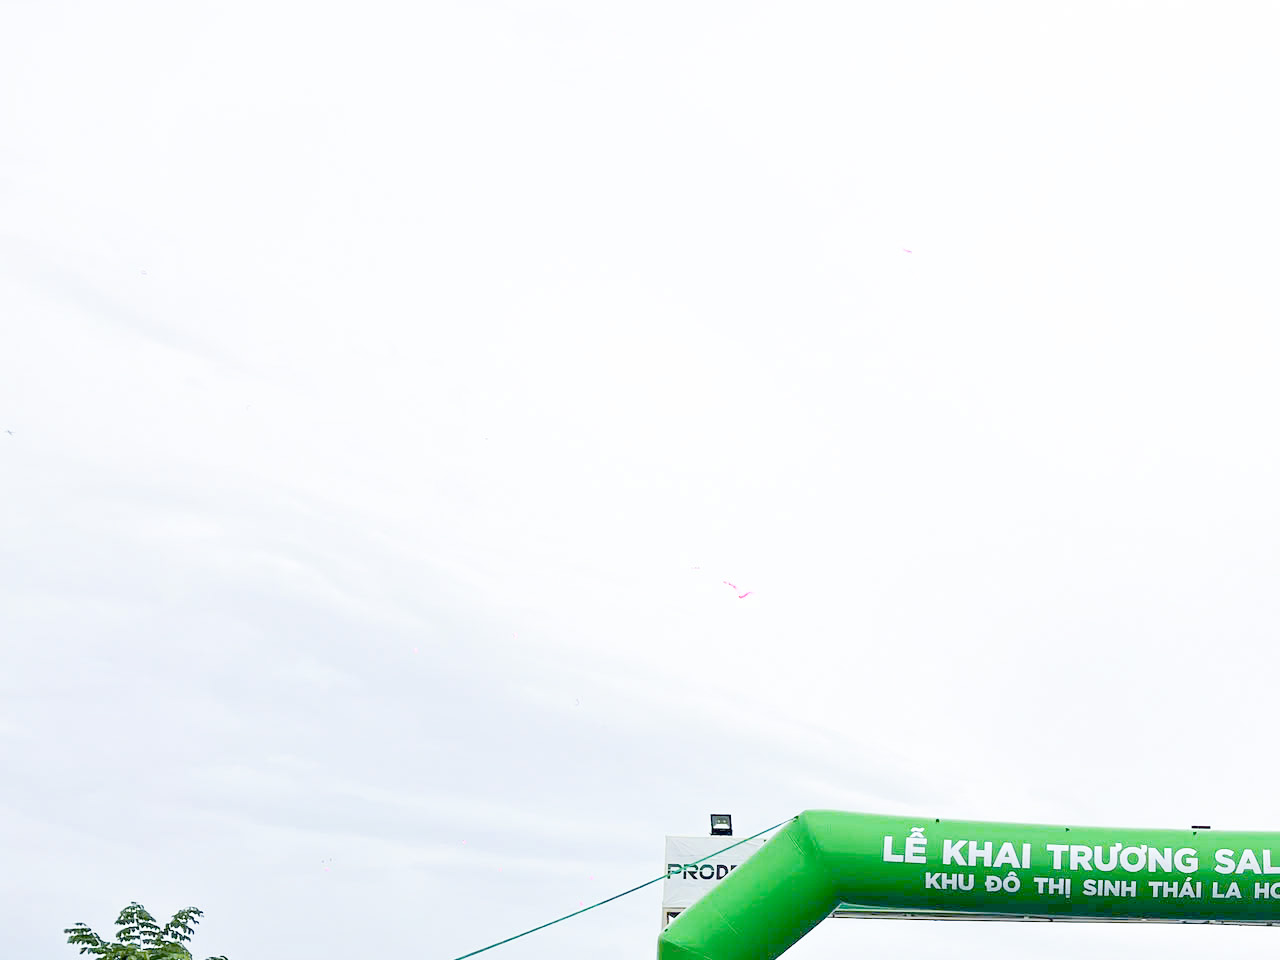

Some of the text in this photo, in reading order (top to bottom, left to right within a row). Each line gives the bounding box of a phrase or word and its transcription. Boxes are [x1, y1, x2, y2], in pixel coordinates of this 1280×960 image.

[883, 826, 927, 864] LỄ
[943, 839, 1030, 868] KHAI
[1047, 842, 1199, 873] TRƯƠNG
[667, 864, 737, 880] PROD
[925, 872, 974, 890] KHU
[985, 871, 1020, 892] ĐÔ
[1034, 877, 1071, 898] THỊ
[1083, 879, 1136, 896] SINH
[1152, 877, 1201, 898] THÁI
[1213, 882, 1242, 898] LA
